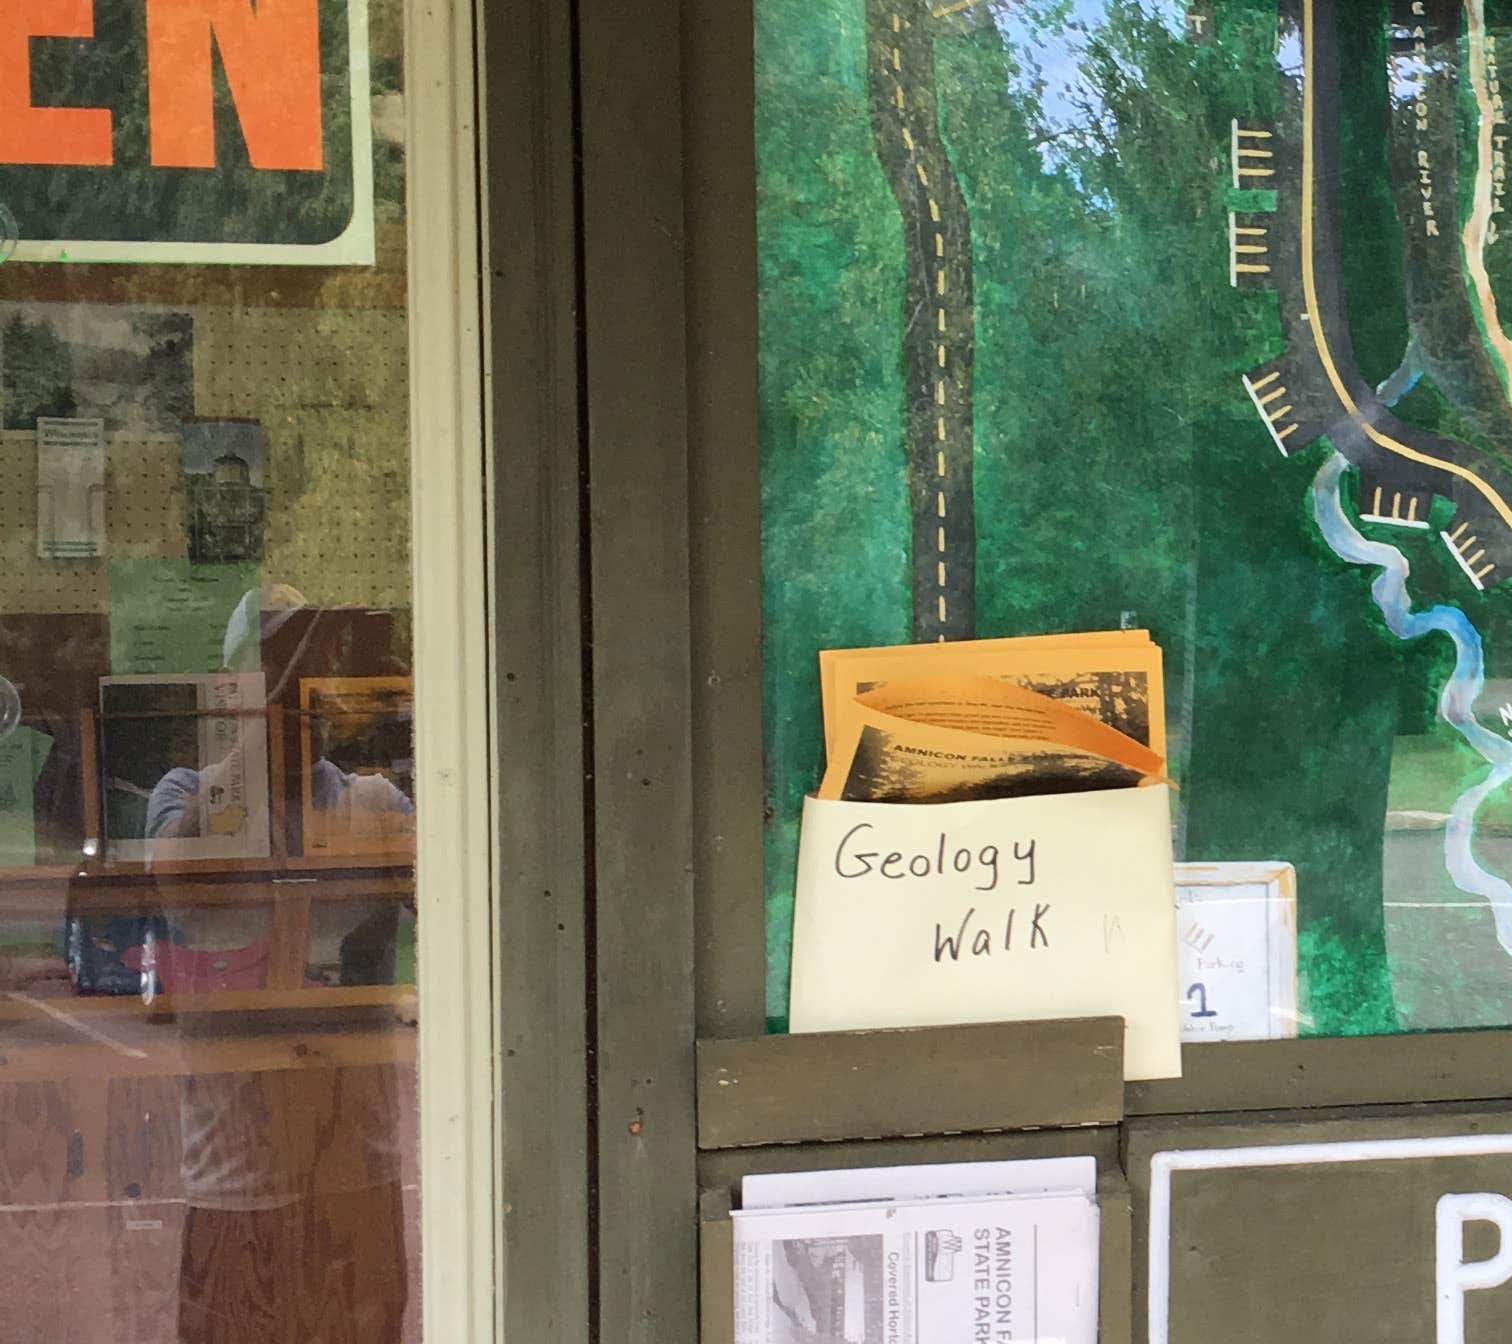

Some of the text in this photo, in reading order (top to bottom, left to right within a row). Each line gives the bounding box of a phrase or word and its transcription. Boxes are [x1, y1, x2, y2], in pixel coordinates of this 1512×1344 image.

[1417, 150, 1439, 236] RIVER
[1492, 136, 1508, 213] TRAIL
[894, 744, 968, 761] AMNICON
[835, 823, 1037, 890] Geology
[933, 903, 1051, 963] Walk
[888, 1252, 899, 1306] Covered
[974, 1228, 991, 1290] STATE
[995, 1227, 1012, 1323] AMNICON
